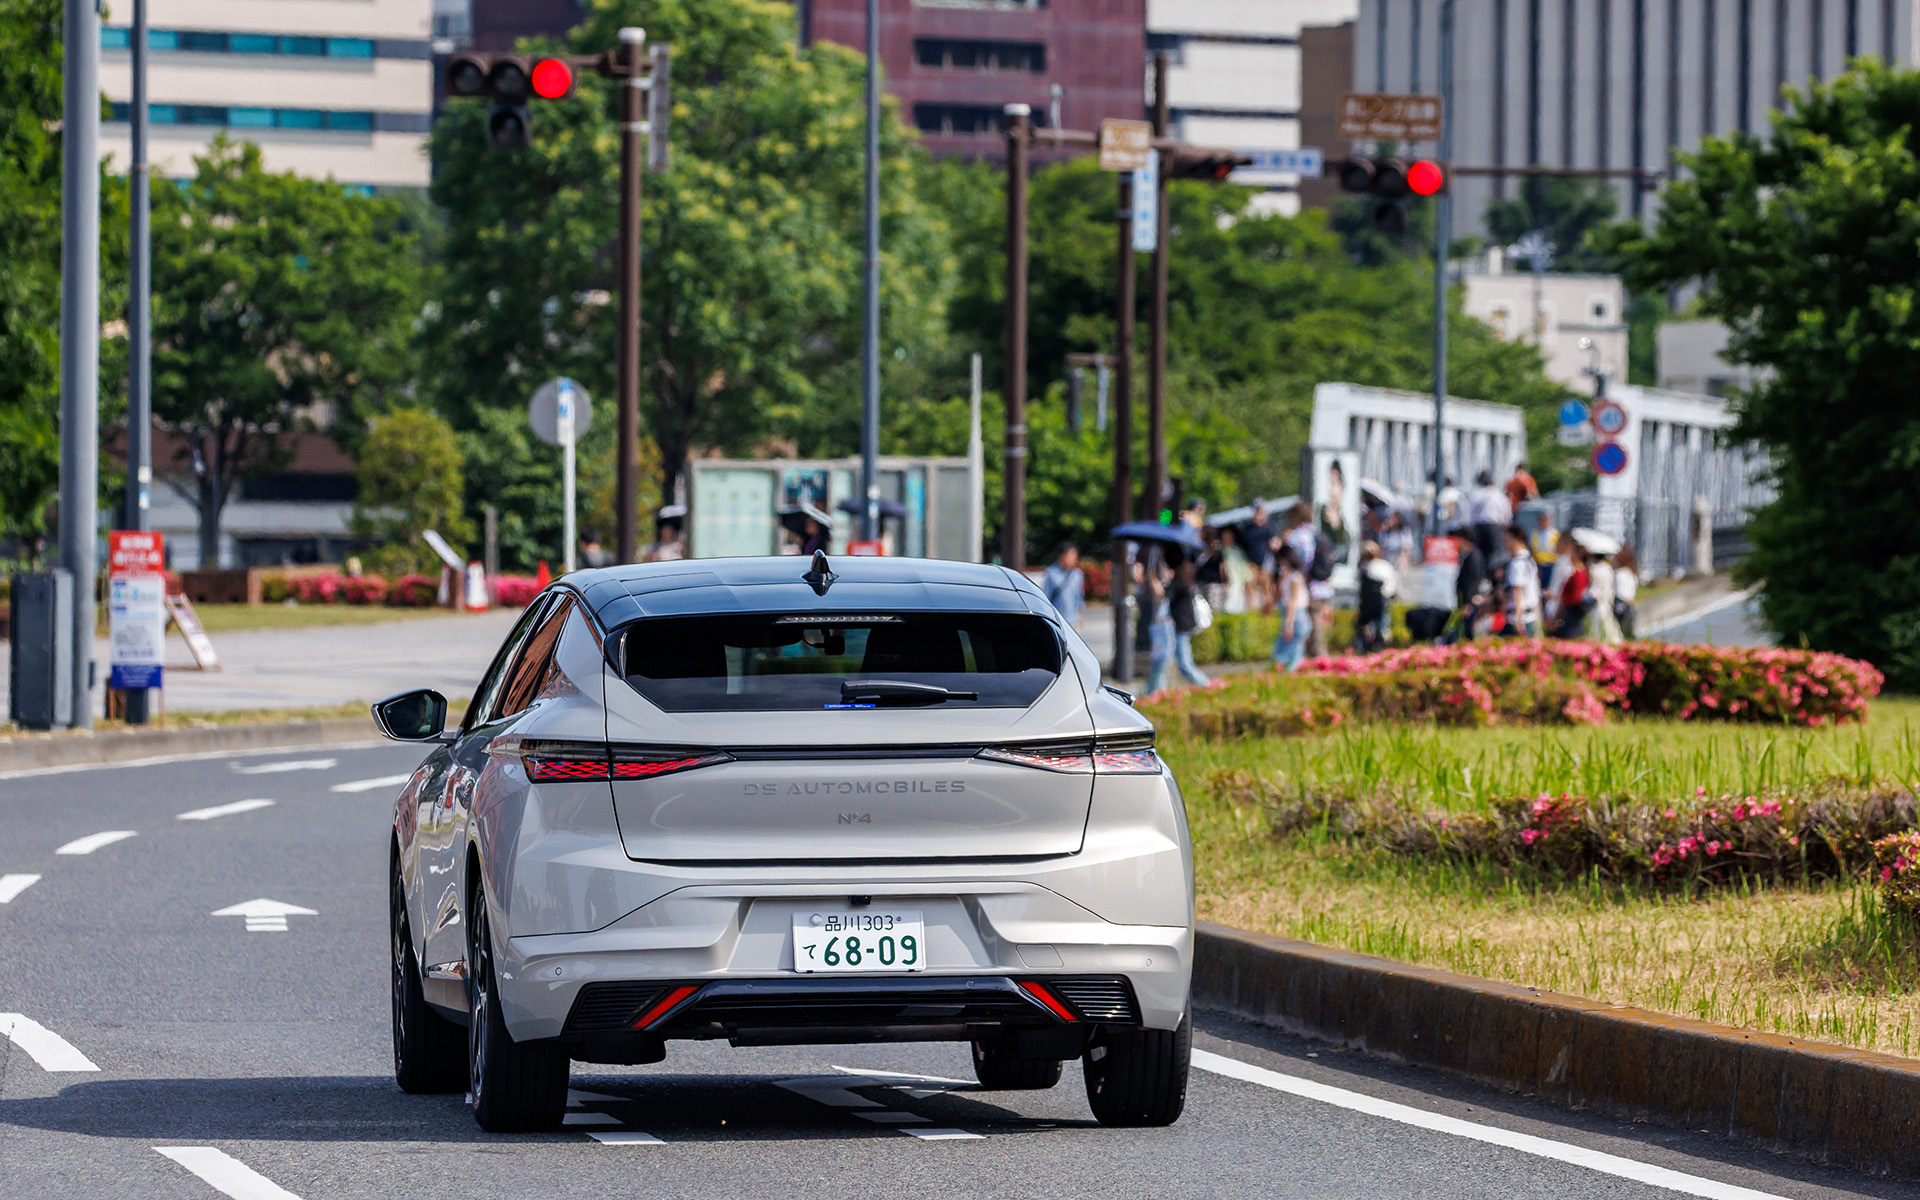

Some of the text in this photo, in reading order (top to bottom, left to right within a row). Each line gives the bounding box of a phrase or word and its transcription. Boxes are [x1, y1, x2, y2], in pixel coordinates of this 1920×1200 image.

[744, 780, 966, 796] DS AUTOMOBILES
[802, 935, 918, 967] て 68-09
